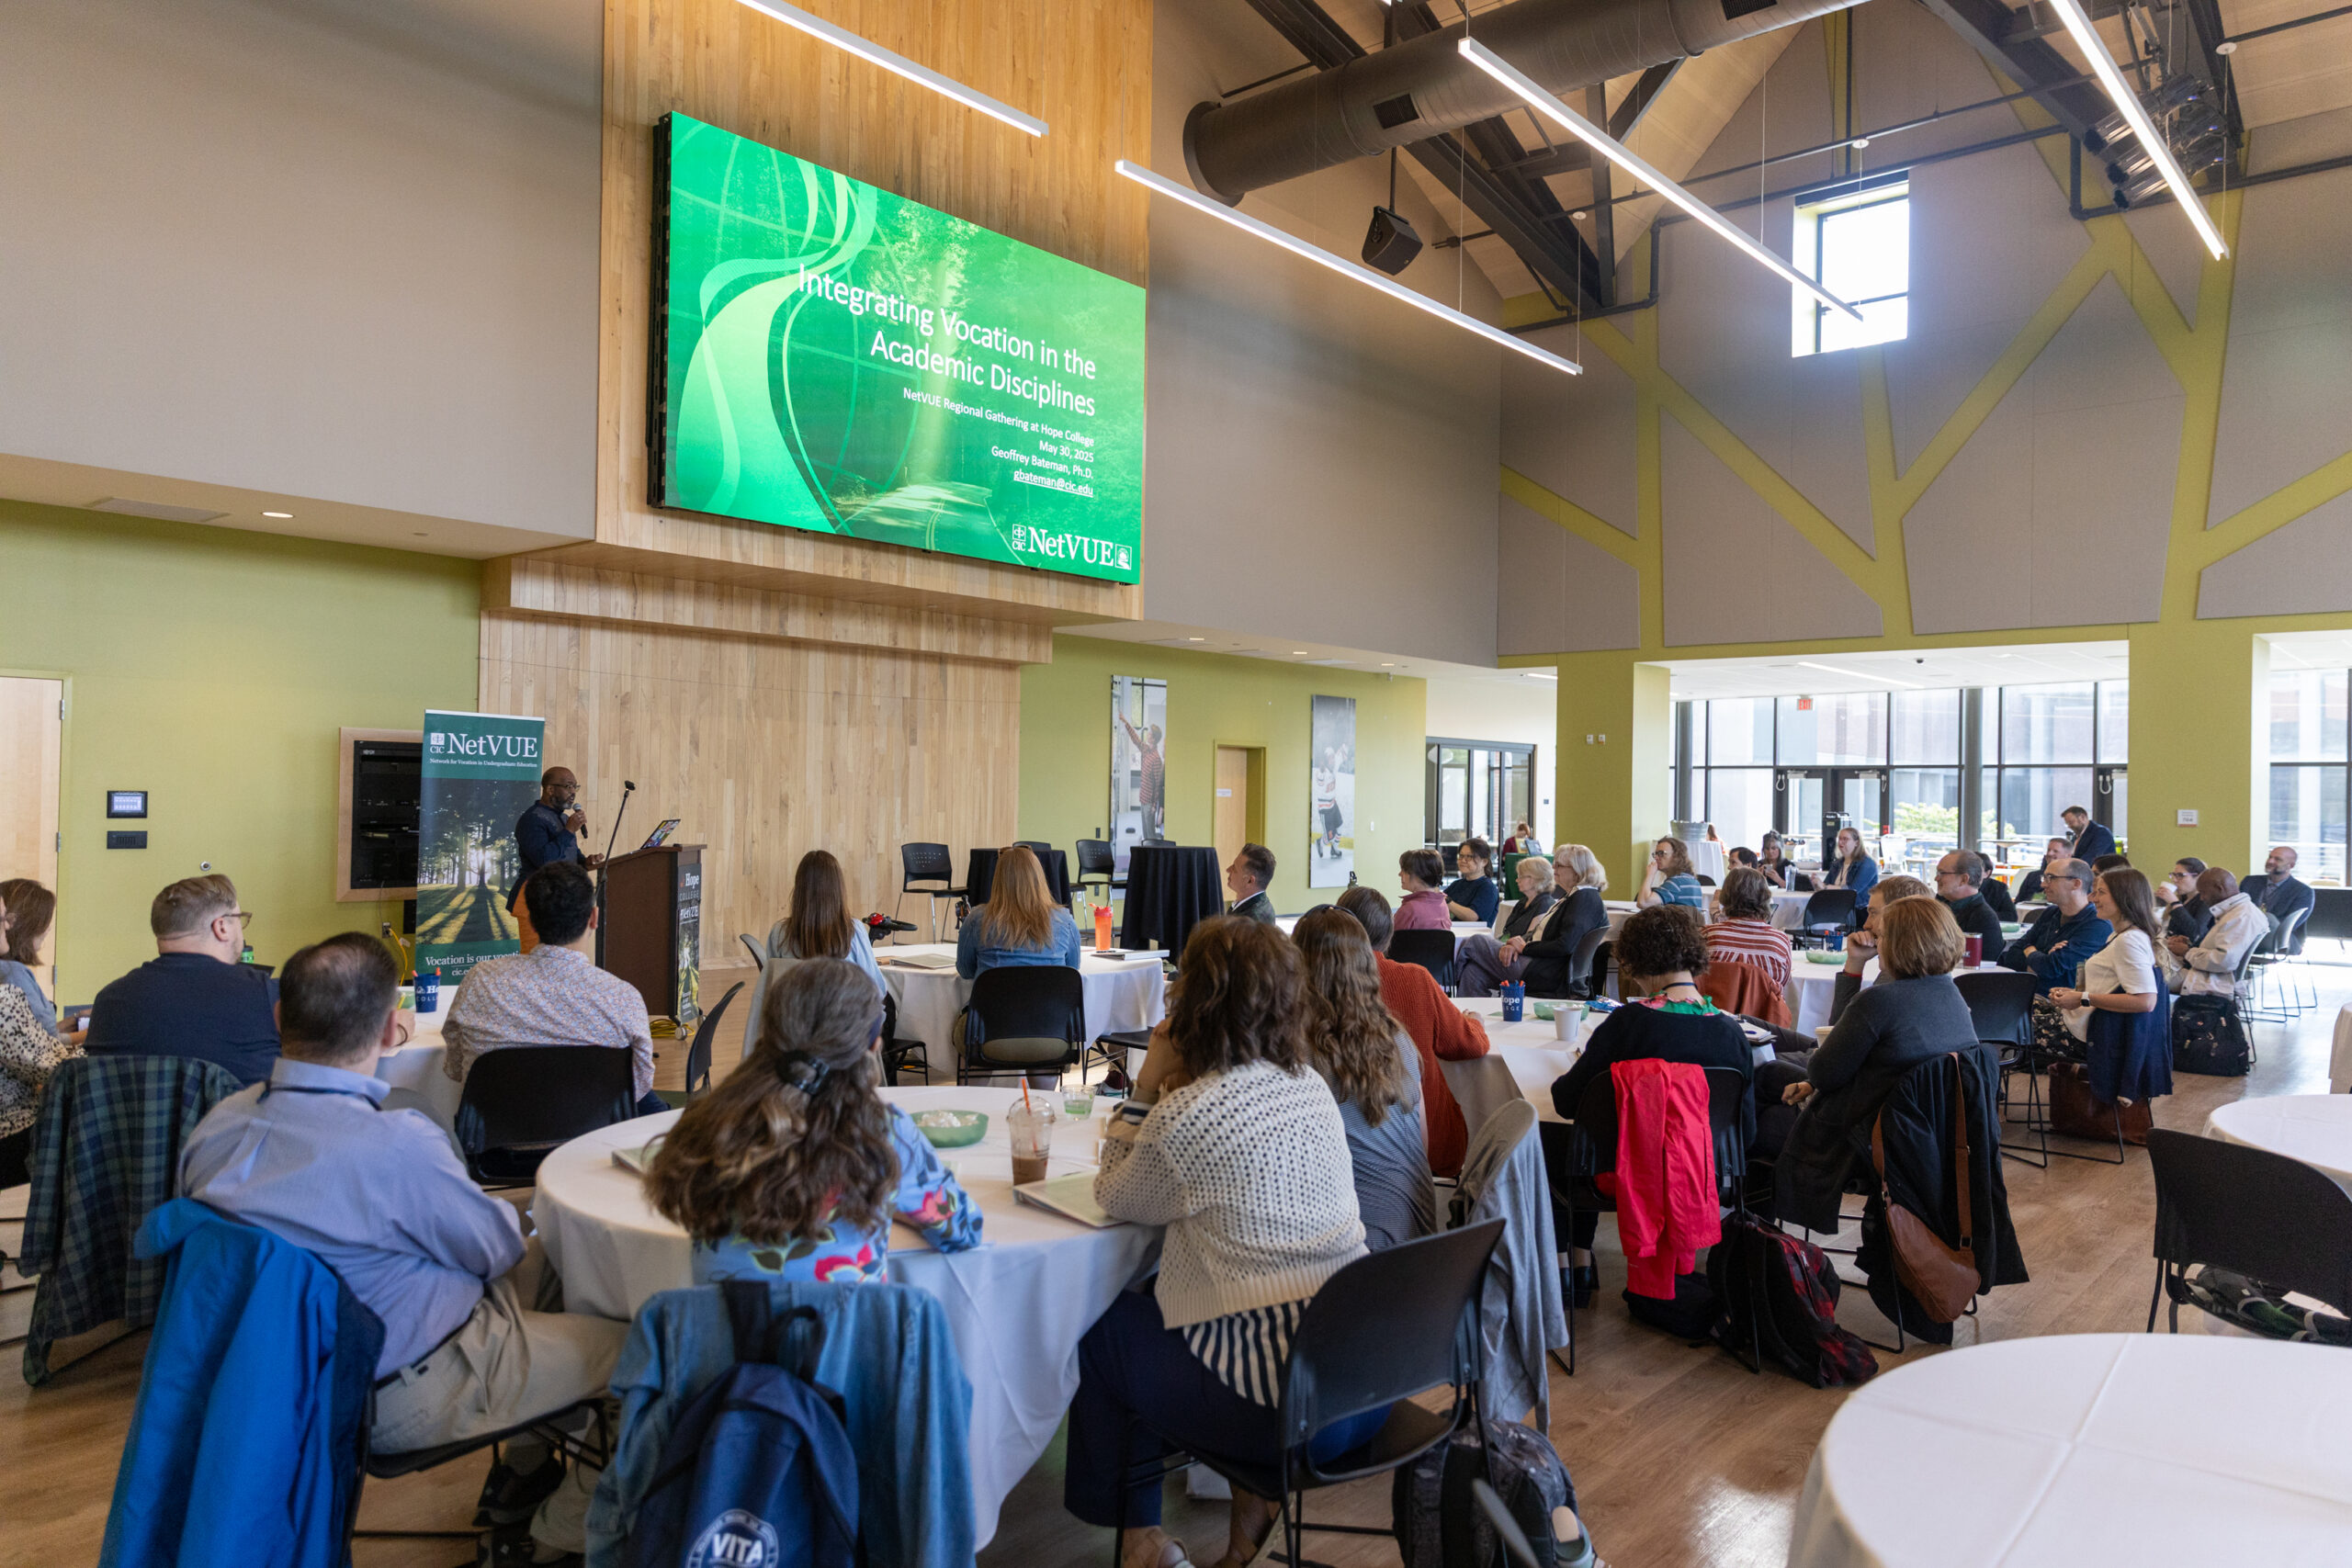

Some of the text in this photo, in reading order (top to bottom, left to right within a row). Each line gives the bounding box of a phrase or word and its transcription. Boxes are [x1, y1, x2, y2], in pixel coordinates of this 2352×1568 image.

[799, 263, 1096, 379] Integrating Vocation in the
[870, 330, 1095, 416] Academic Disciplines
[903, 387, 1094, 447] NetVUE Regional Gathering at Hope College
[991, 446, 1094, 479] Geoffrey Bateman, Ph.D.
[1039, 440, 1094, 463] May 30, 2025
[1013, 468, 1093, 497] gbateman@cic.edu
[1012, 526, 1114, 567] CIC NetVUE
[429, 732, 538, 758] CIC NetVUE
[684, 873, 700, 889] Hope
[425, 955, 465, 966] Vocation
[466, 953, 474, 964] is
[476, 954, 492, 963] our
[712, 1532, 763, 1564] VITA
